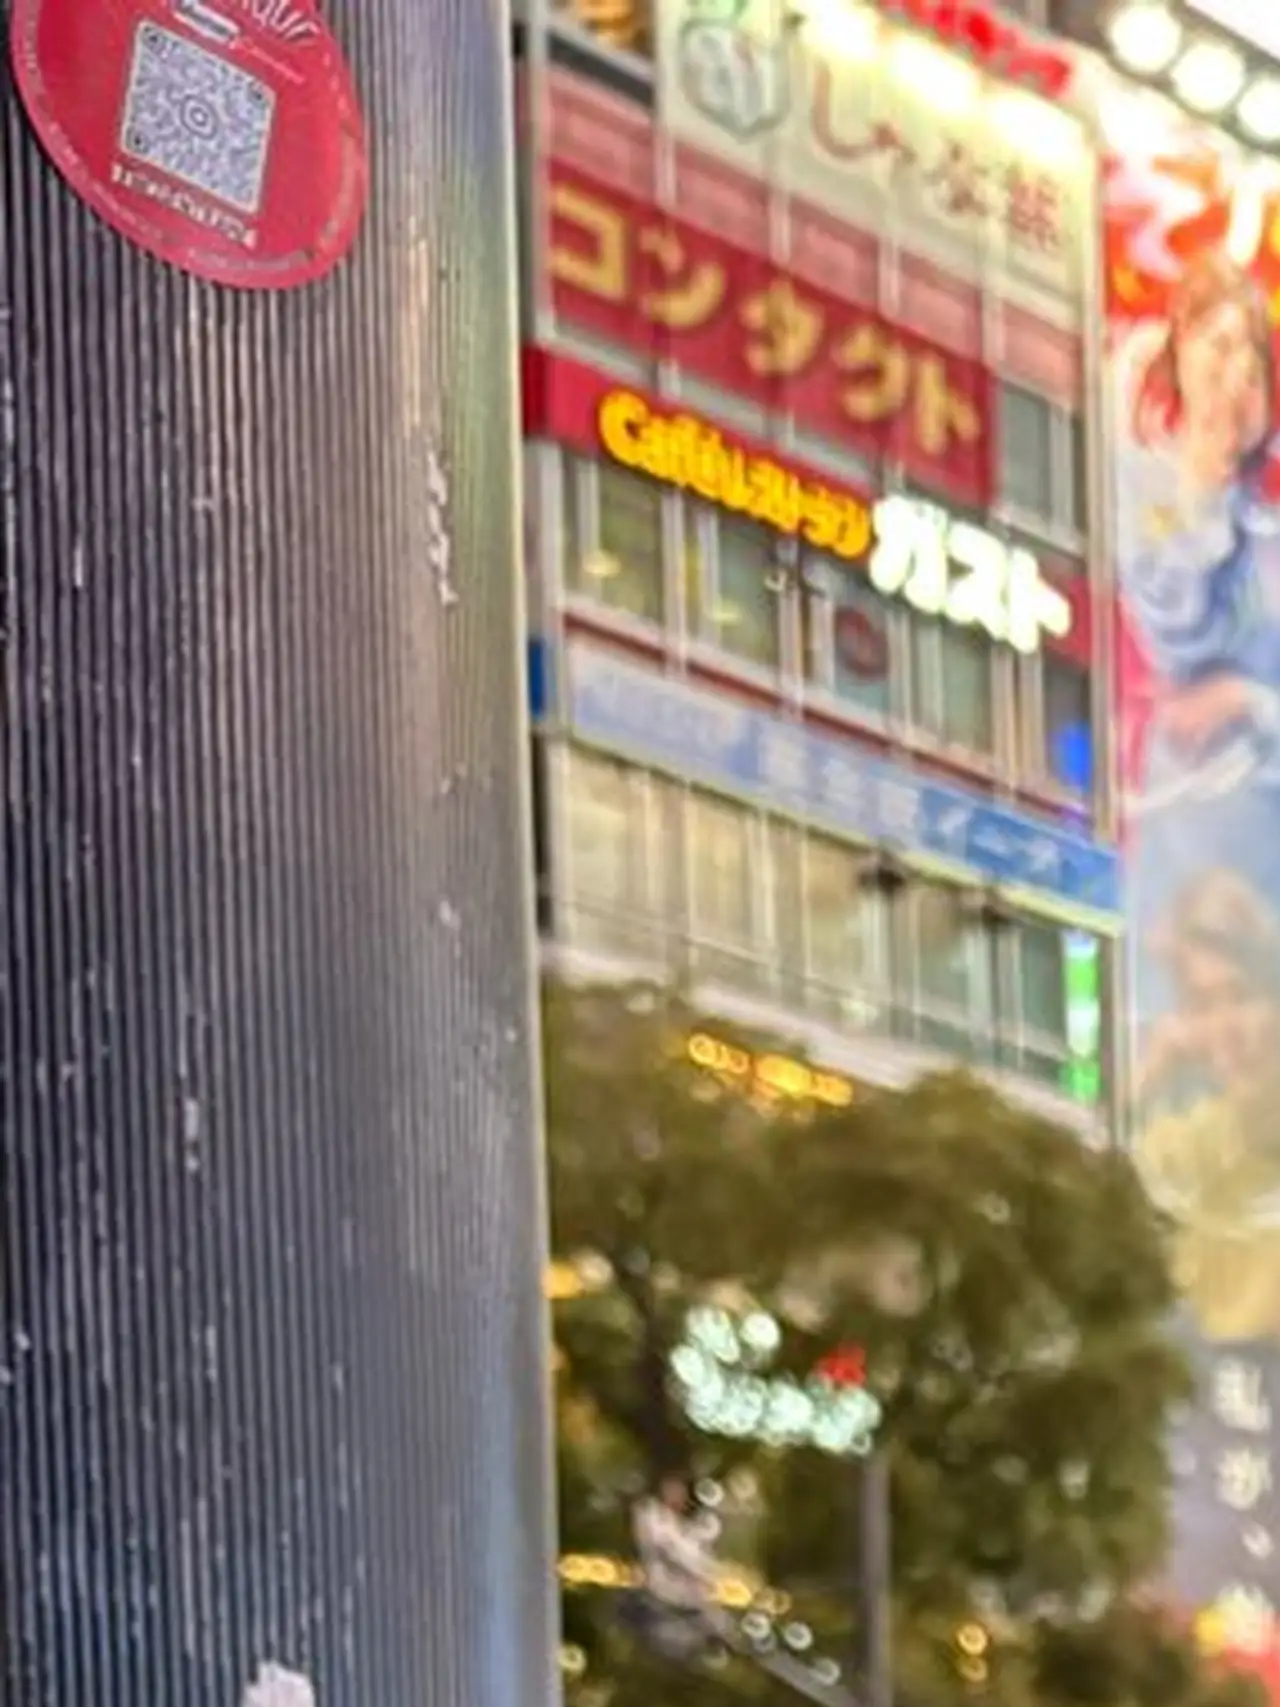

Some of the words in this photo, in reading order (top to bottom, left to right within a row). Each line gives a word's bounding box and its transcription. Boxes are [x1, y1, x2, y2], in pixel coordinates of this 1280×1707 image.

[550, 184, 982, 456] コンタクト
[868, 492, 1072, 654] ガスト
